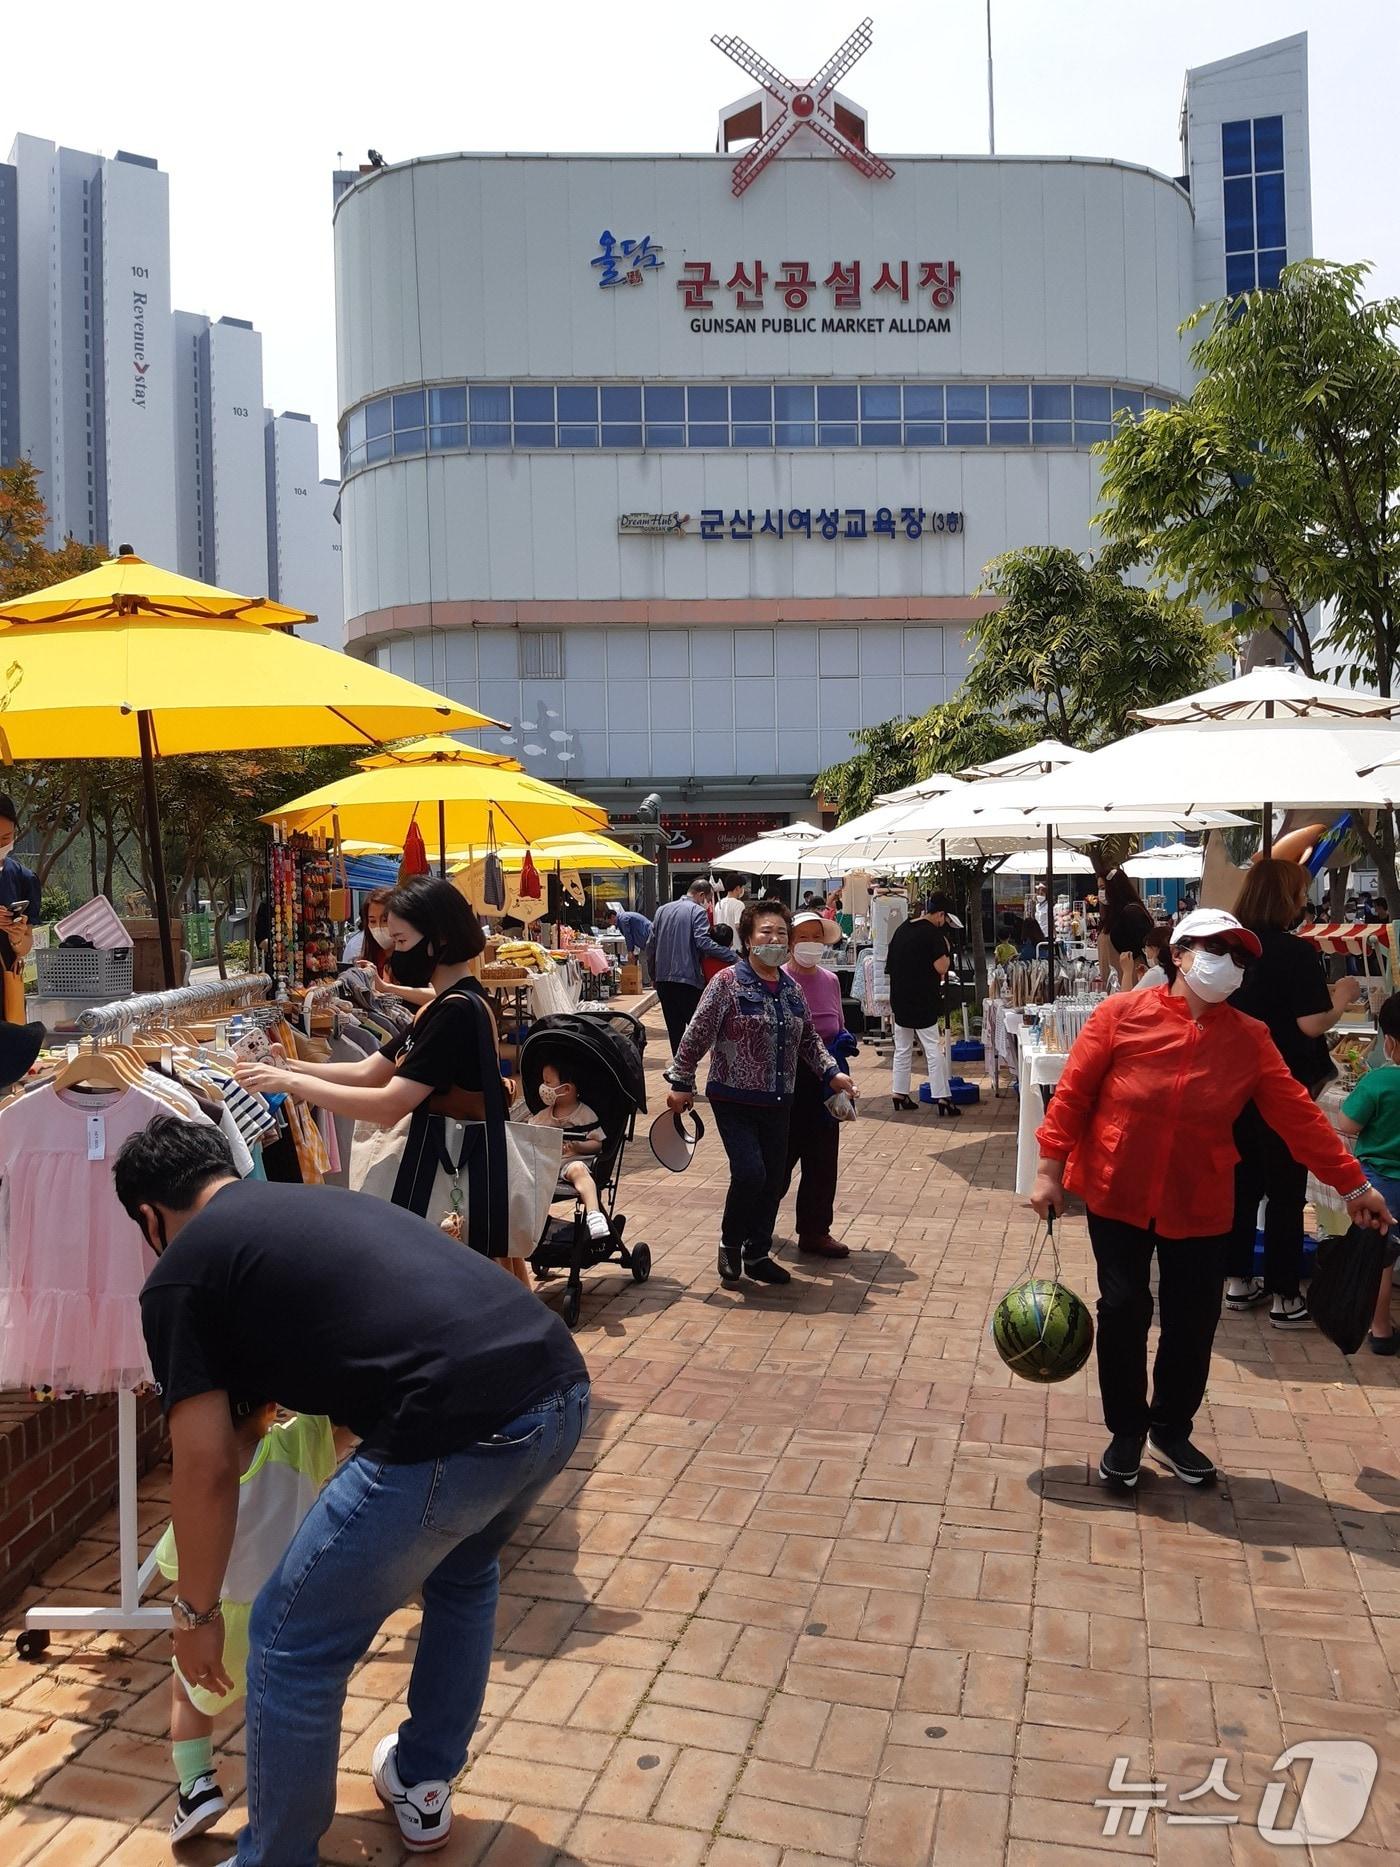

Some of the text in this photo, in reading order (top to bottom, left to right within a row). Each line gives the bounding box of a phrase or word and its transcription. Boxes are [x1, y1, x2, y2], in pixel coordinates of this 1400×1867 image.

[131, 266, 149, 279] 101
[677, 260, 961, 310] 군산공설시장
[690, 317, 951, 333] GUNSAN PUBLIC MARKET ALLDAM
[131, 290, 148, 410] Revenue stay
[233, 407, 249, 418] 103
[294, 487, 307, 496] 104
[621, 513, 674, 528] Dream Hub
[700, 507, 926, 541] 군산시여성교육장
